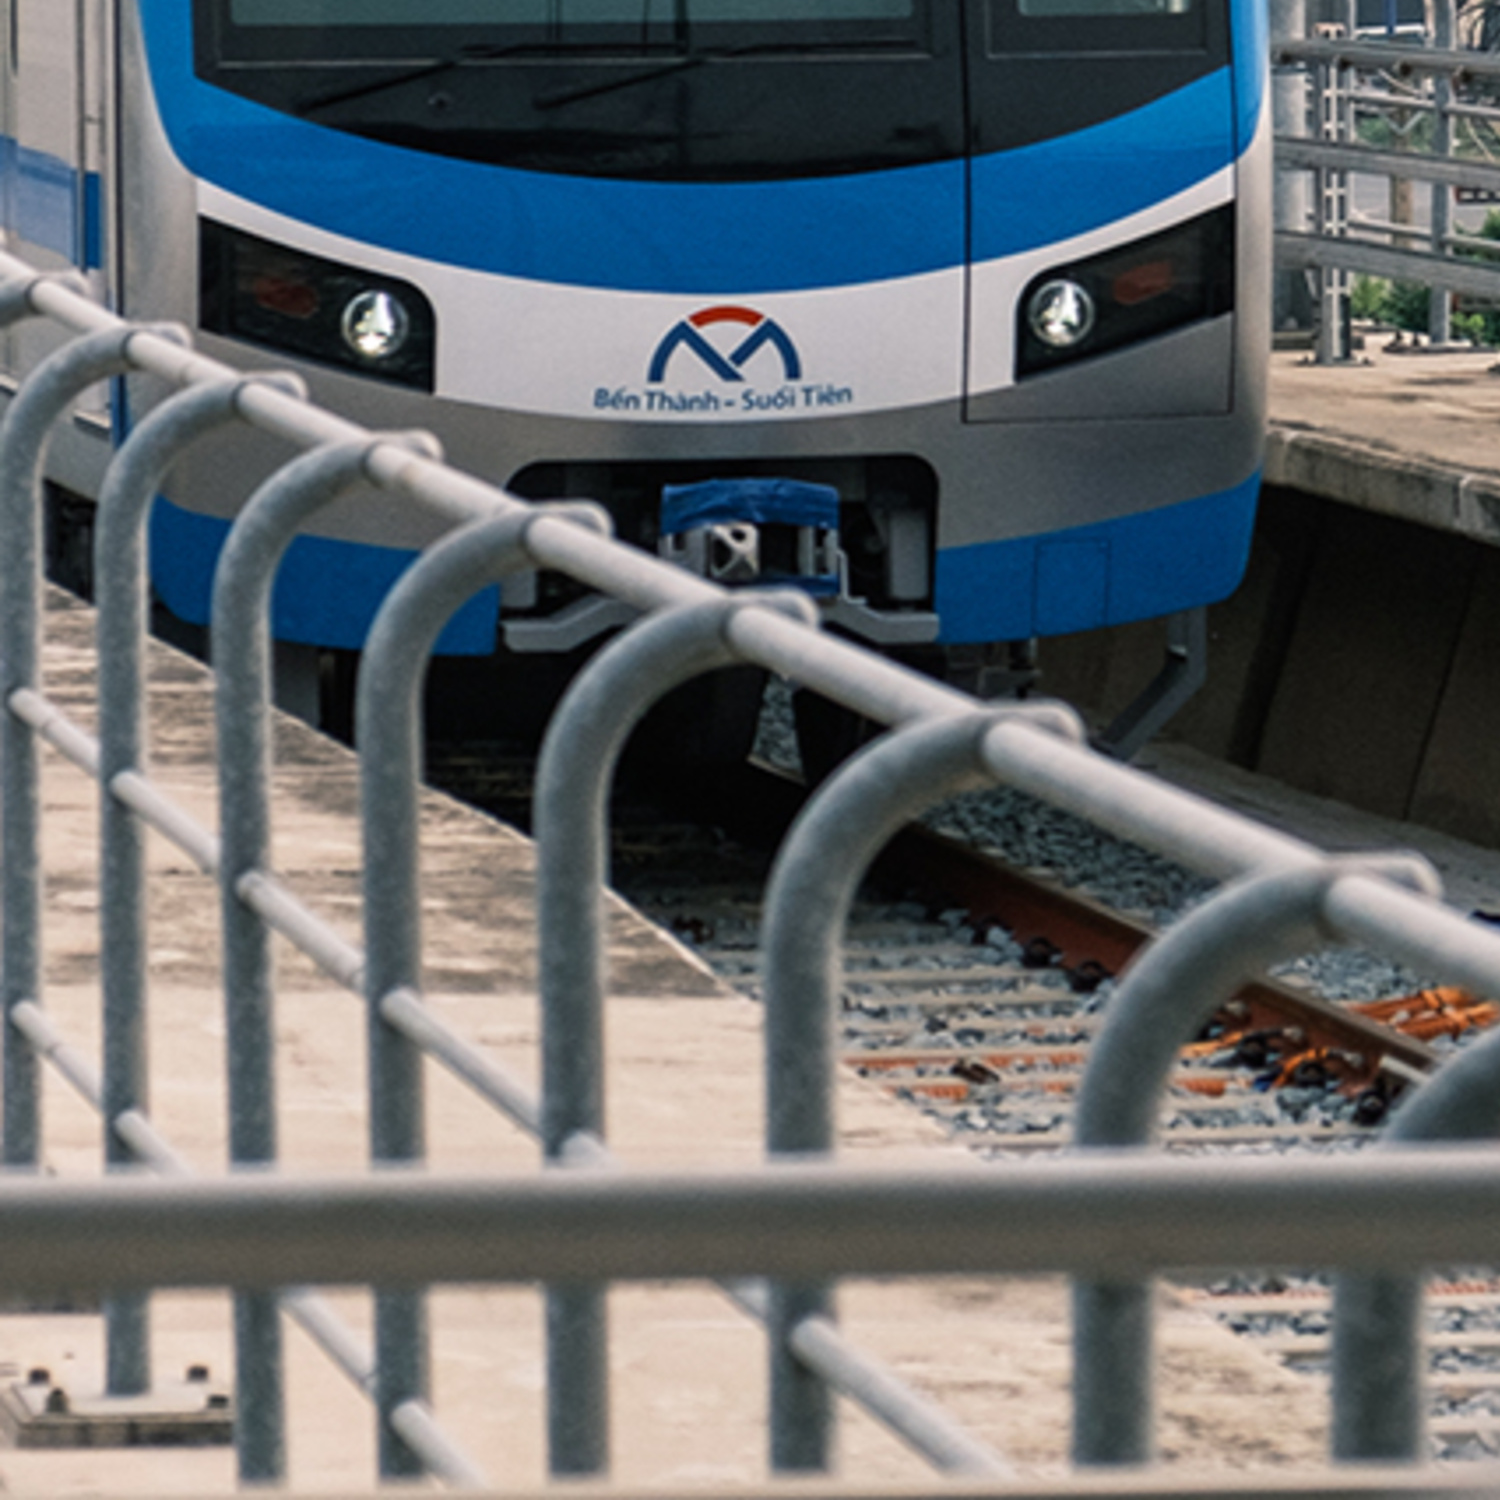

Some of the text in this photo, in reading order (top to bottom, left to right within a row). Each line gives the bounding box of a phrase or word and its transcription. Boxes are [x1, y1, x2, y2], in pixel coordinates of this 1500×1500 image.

[593, 386, 641, 411] Bến
[644, 389, 720, 413] Thành
[741, 386, 798, 412] Suối
